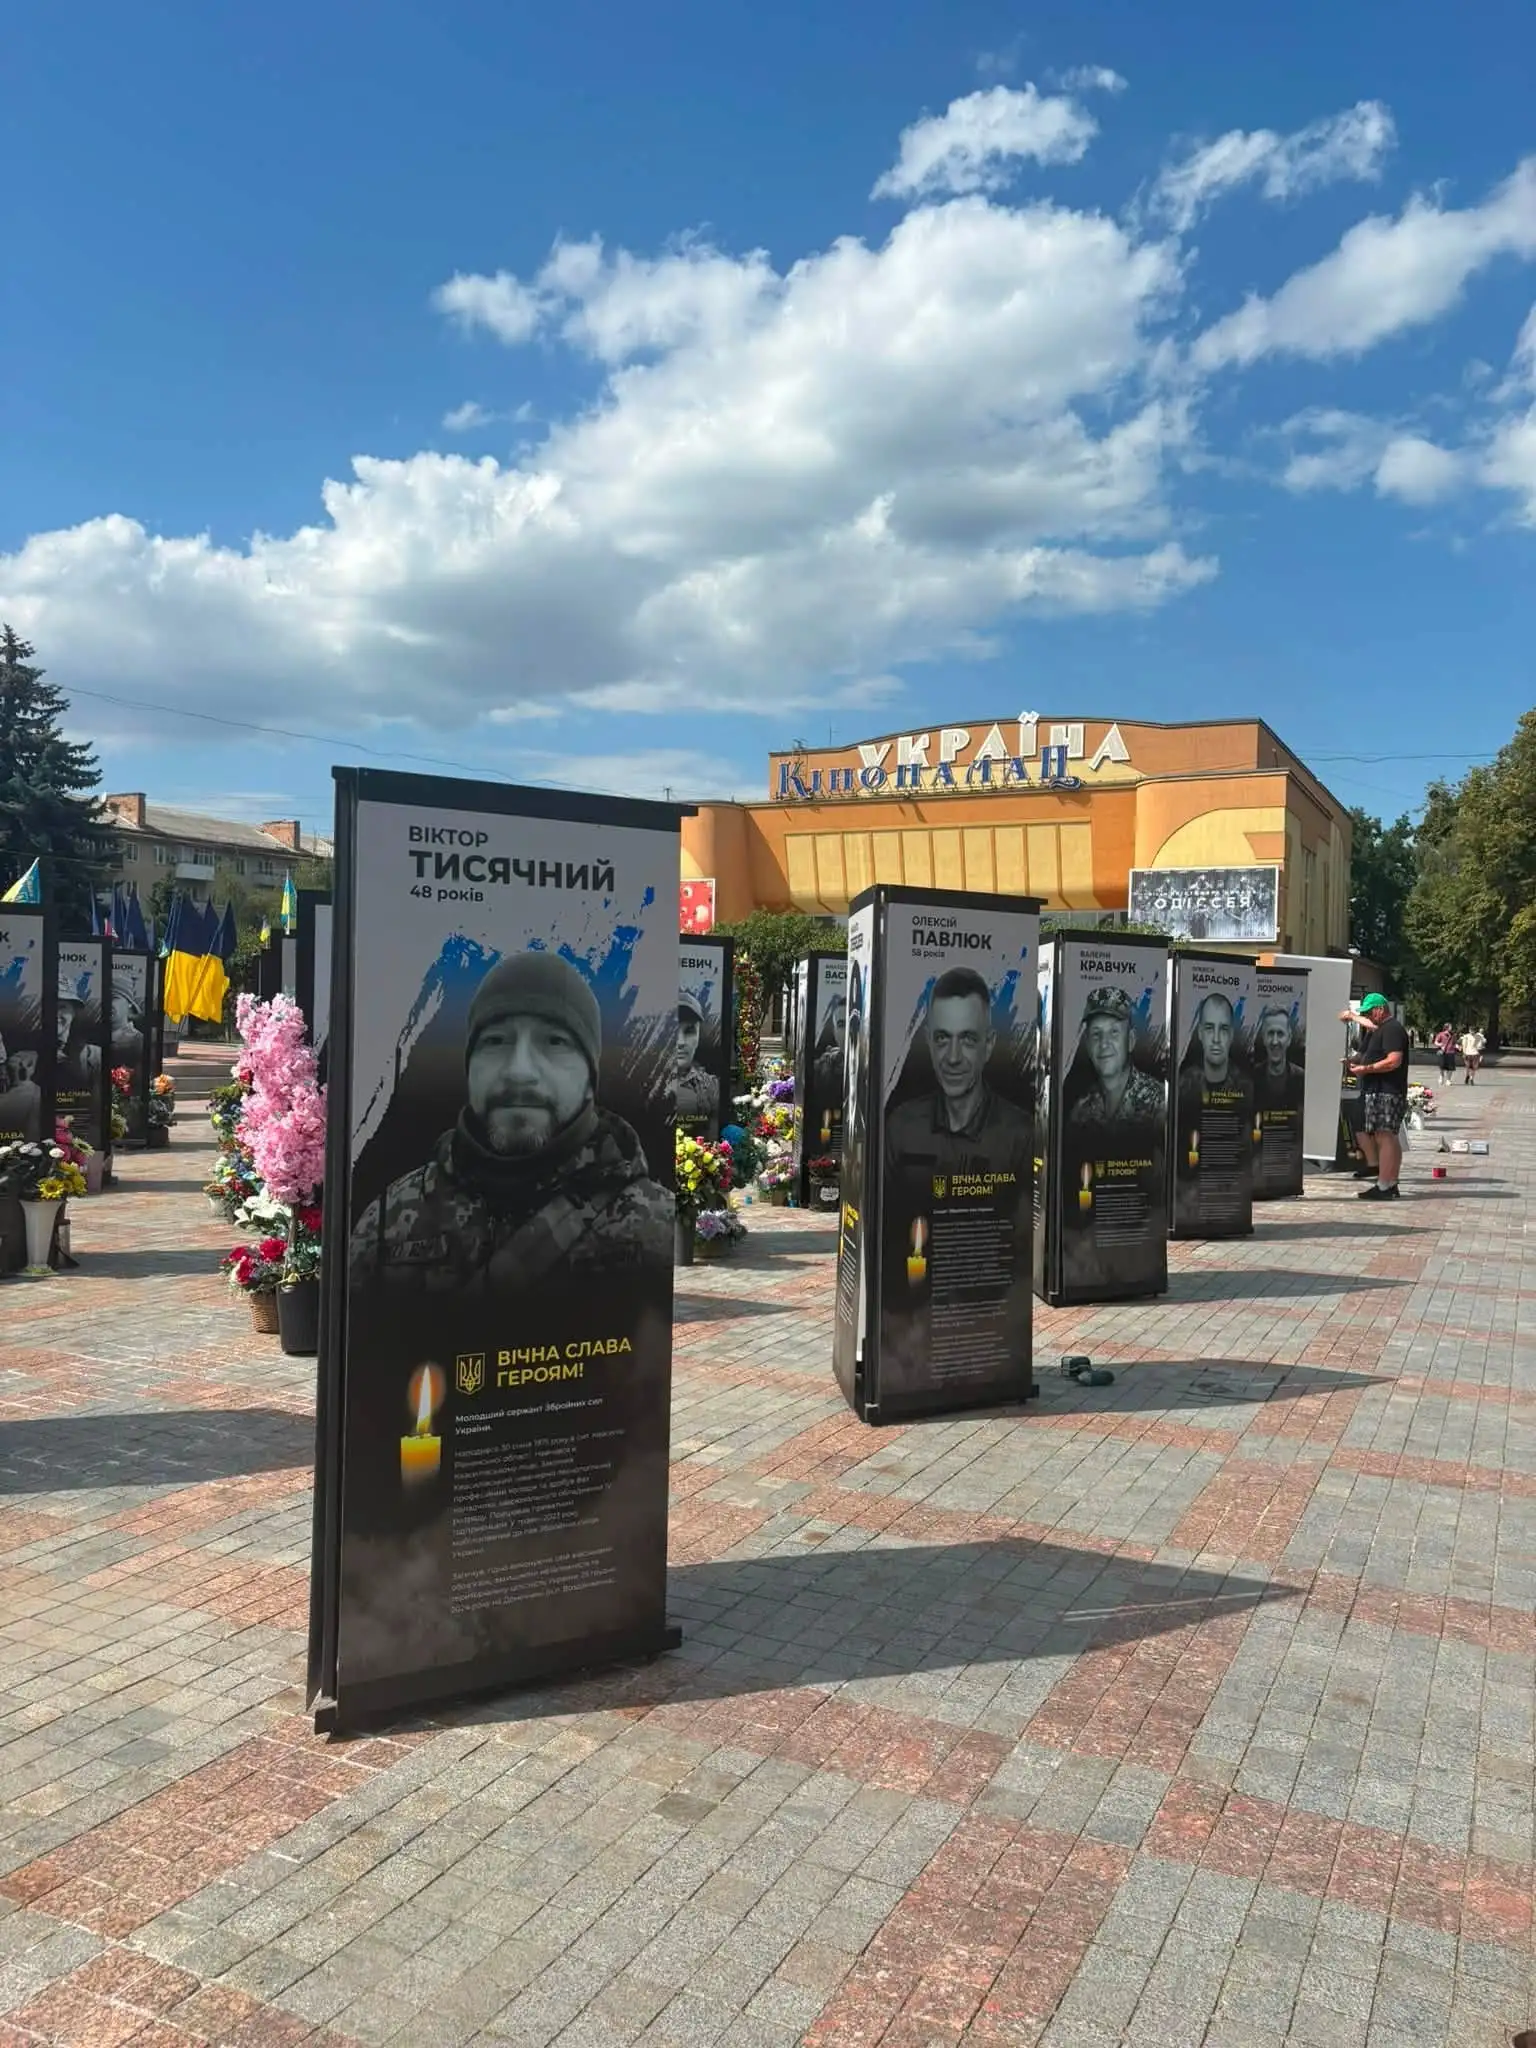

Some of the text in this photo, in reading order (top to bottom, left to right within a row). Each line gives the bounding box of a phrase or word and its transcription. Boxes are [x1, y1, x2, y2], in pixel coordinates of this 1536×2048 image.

[858, 711, 1131, 771] УКРАЇНА
[408, 826, 489, 847] ВІКТОР
[408, 849, 615, 892] ТИСЯЧНИЙ
[410, 884, 484, 902] 48 років
[912, 915, 957, 928] ОЛЕКСІЙ
[912, 929, 993, 950] ПАВЛЮК
[923, 949, 945, 958] років
[1080, 960, 1137, 974] КРАВЧУК
[1192, 973, 1240, 986] КАРАСЬОВ
[1257, 984, 1294, 993] ЛОЗОНЮК
[952, 1173, 1016, 1185] ВІЧНА СЛАВА
[951, 1186, 993, 1197] ГЕРОЯМ!
[497, 1337, 632, 1367] ВІЧНА СЛАВА
[496, 1362, 585, 1388] ГЕРОЯМ!
[455, 1409, 505, 1423] Молодший
[506, 1405, 543, 1417] сержант
[544, 1400, 586, 1413] Збройних
